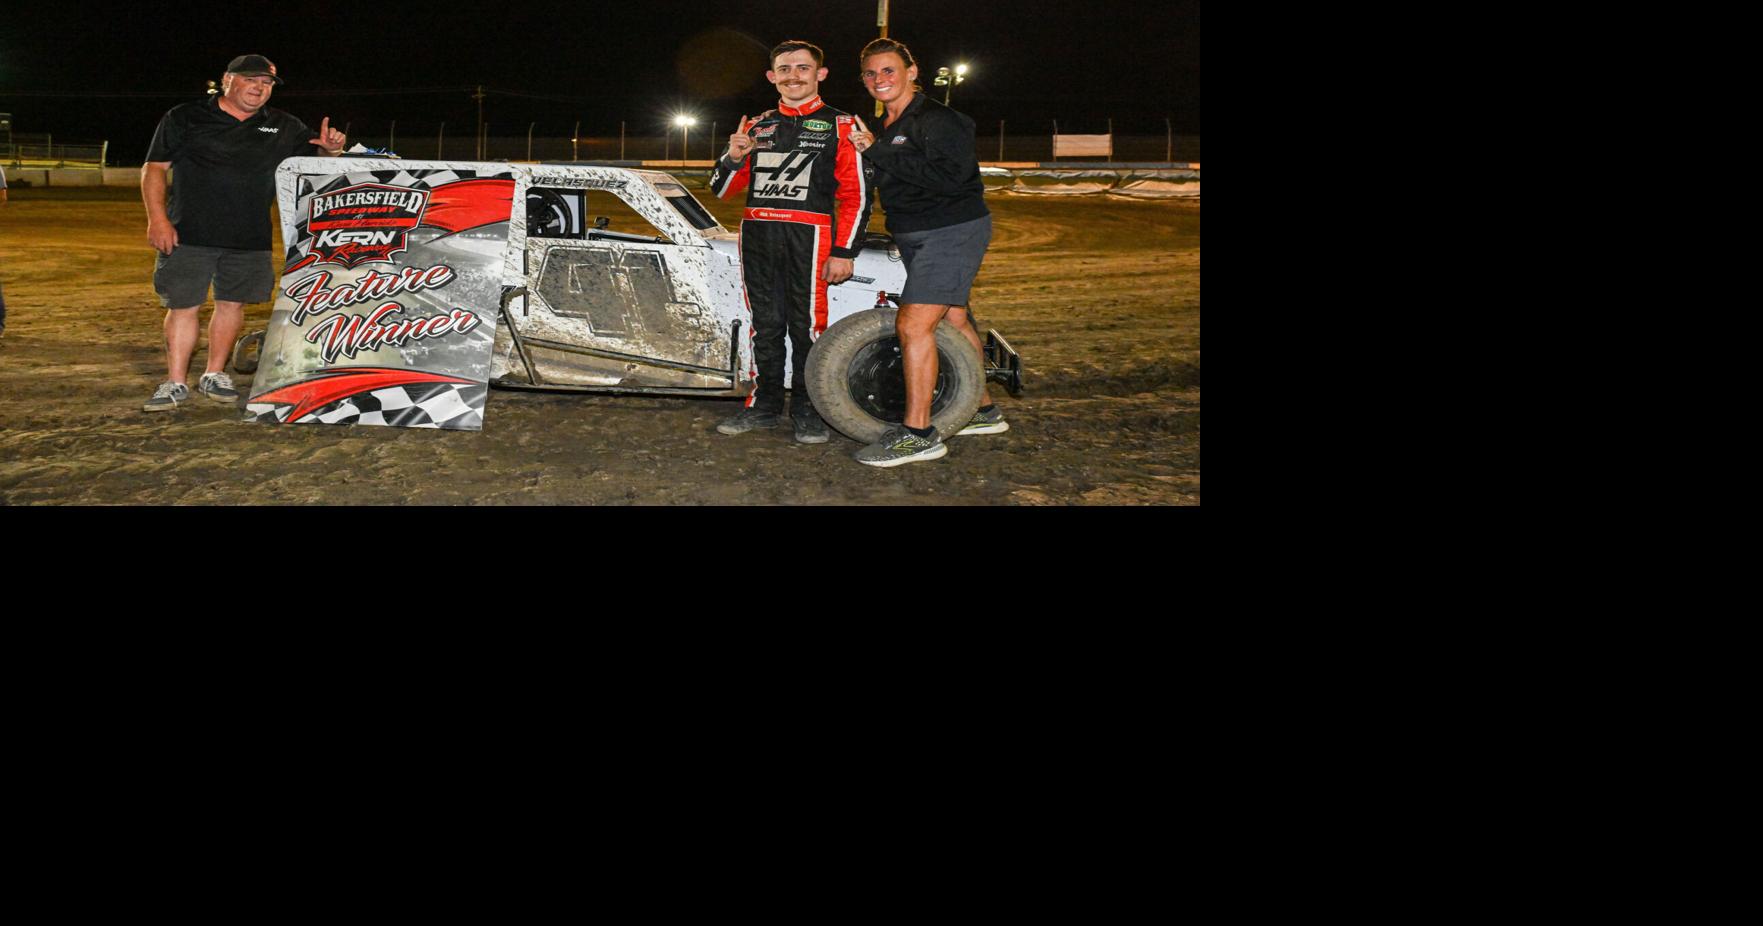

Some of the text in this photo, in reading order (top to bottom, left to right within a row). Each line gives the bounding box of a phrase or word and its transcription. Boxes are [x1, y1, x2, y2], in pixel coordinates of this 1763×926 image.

[753, 183, 809, 198] HAAS
[313, 191, 424, 219] BAKERSFIELD
[315, 229, 397, 249] KERN
[285, 265, 455, 325] Feature
[305, 302, 481, 363] Winner
